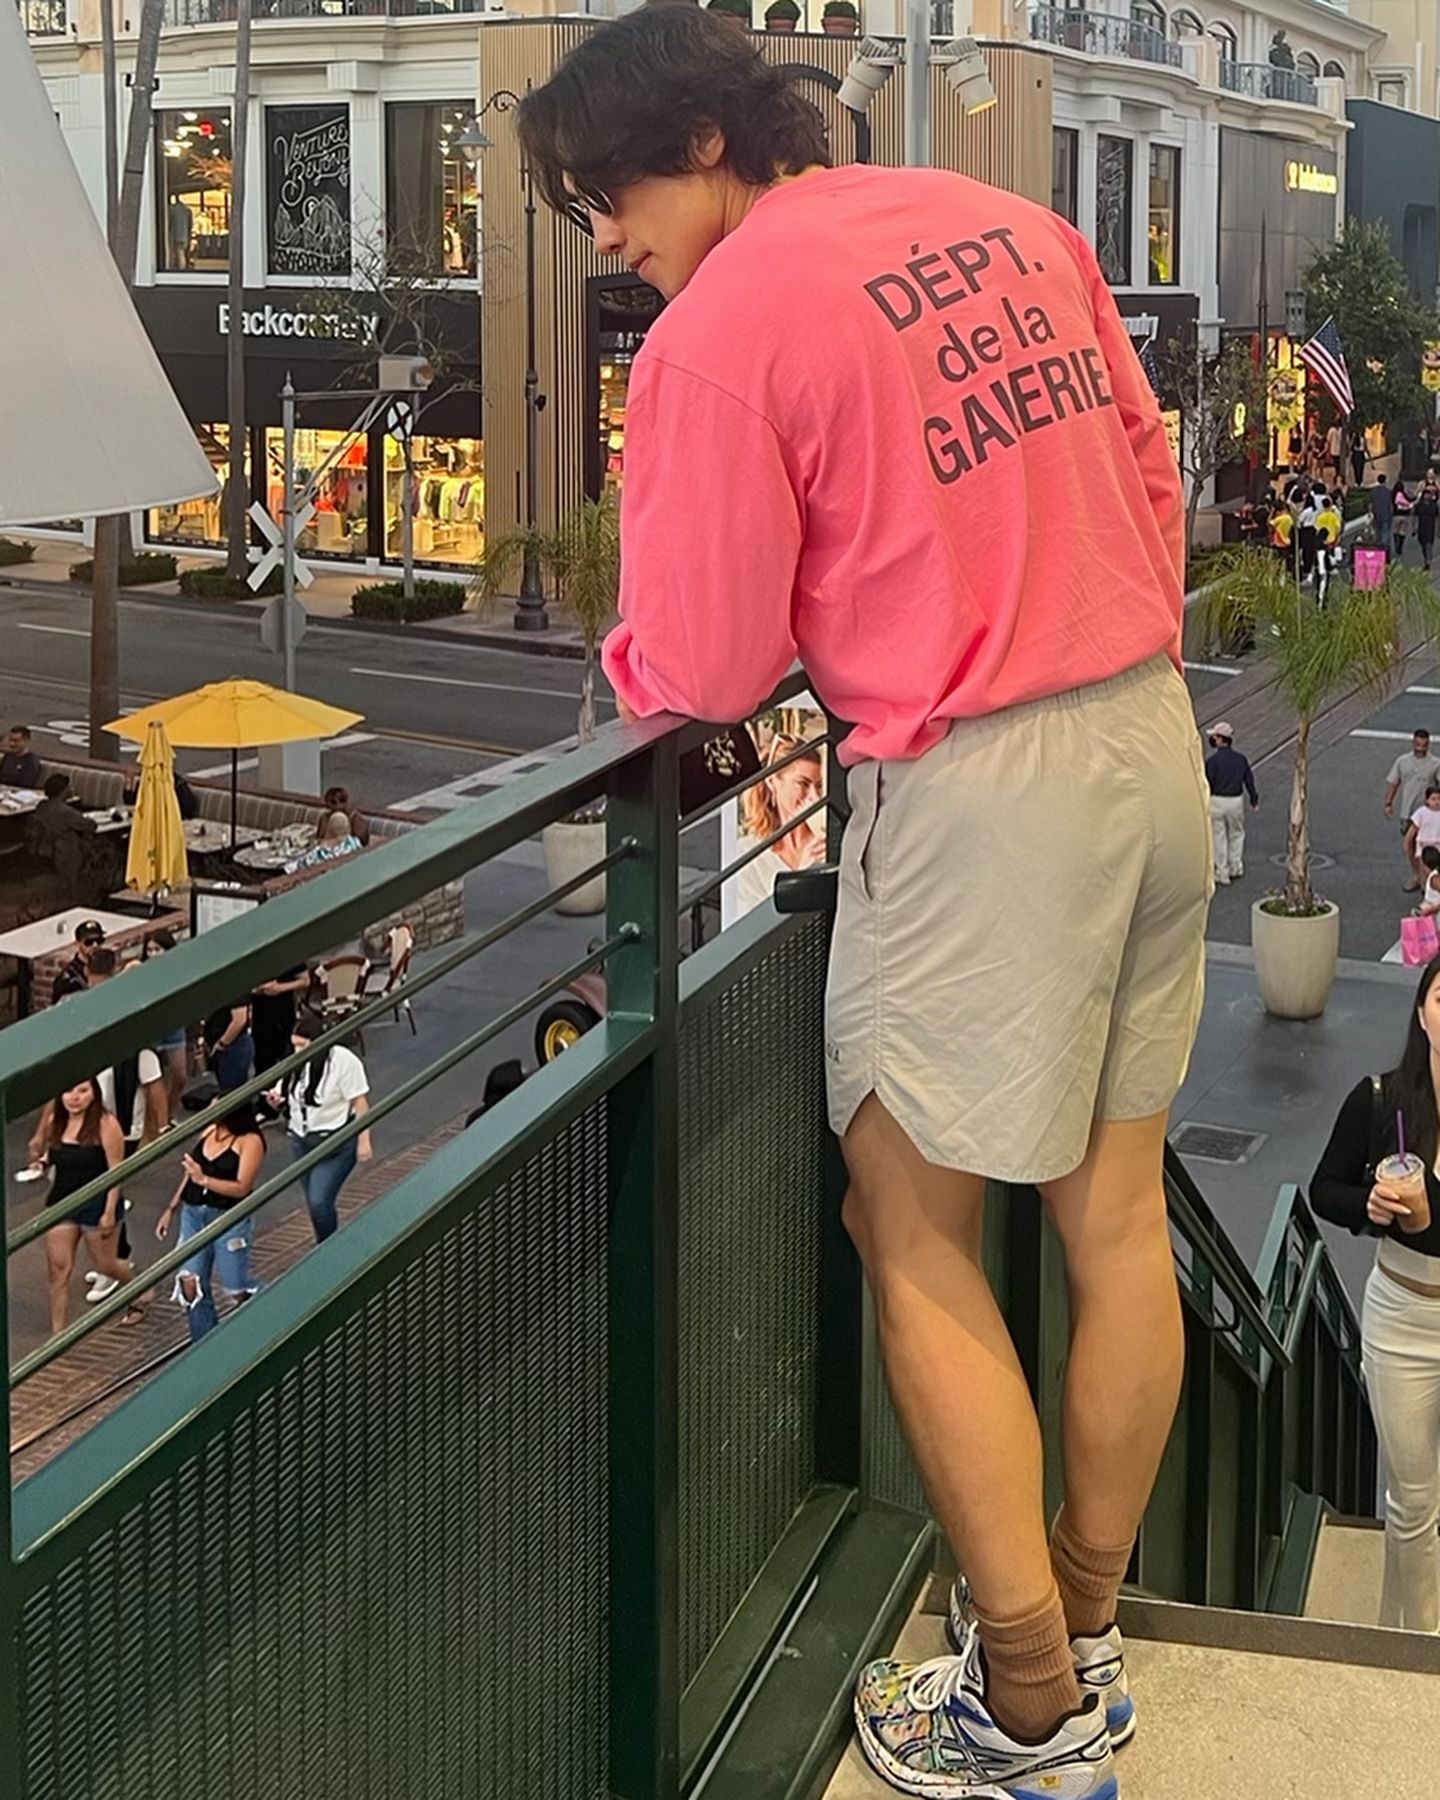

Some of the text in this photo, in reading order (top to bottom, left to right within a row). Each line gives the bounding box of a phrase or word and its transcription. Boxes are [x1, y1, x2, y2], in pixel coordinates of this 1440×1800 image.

[863, 227, 1045, 333] DÉPT.
[936, 296, 1056, 383] de la
